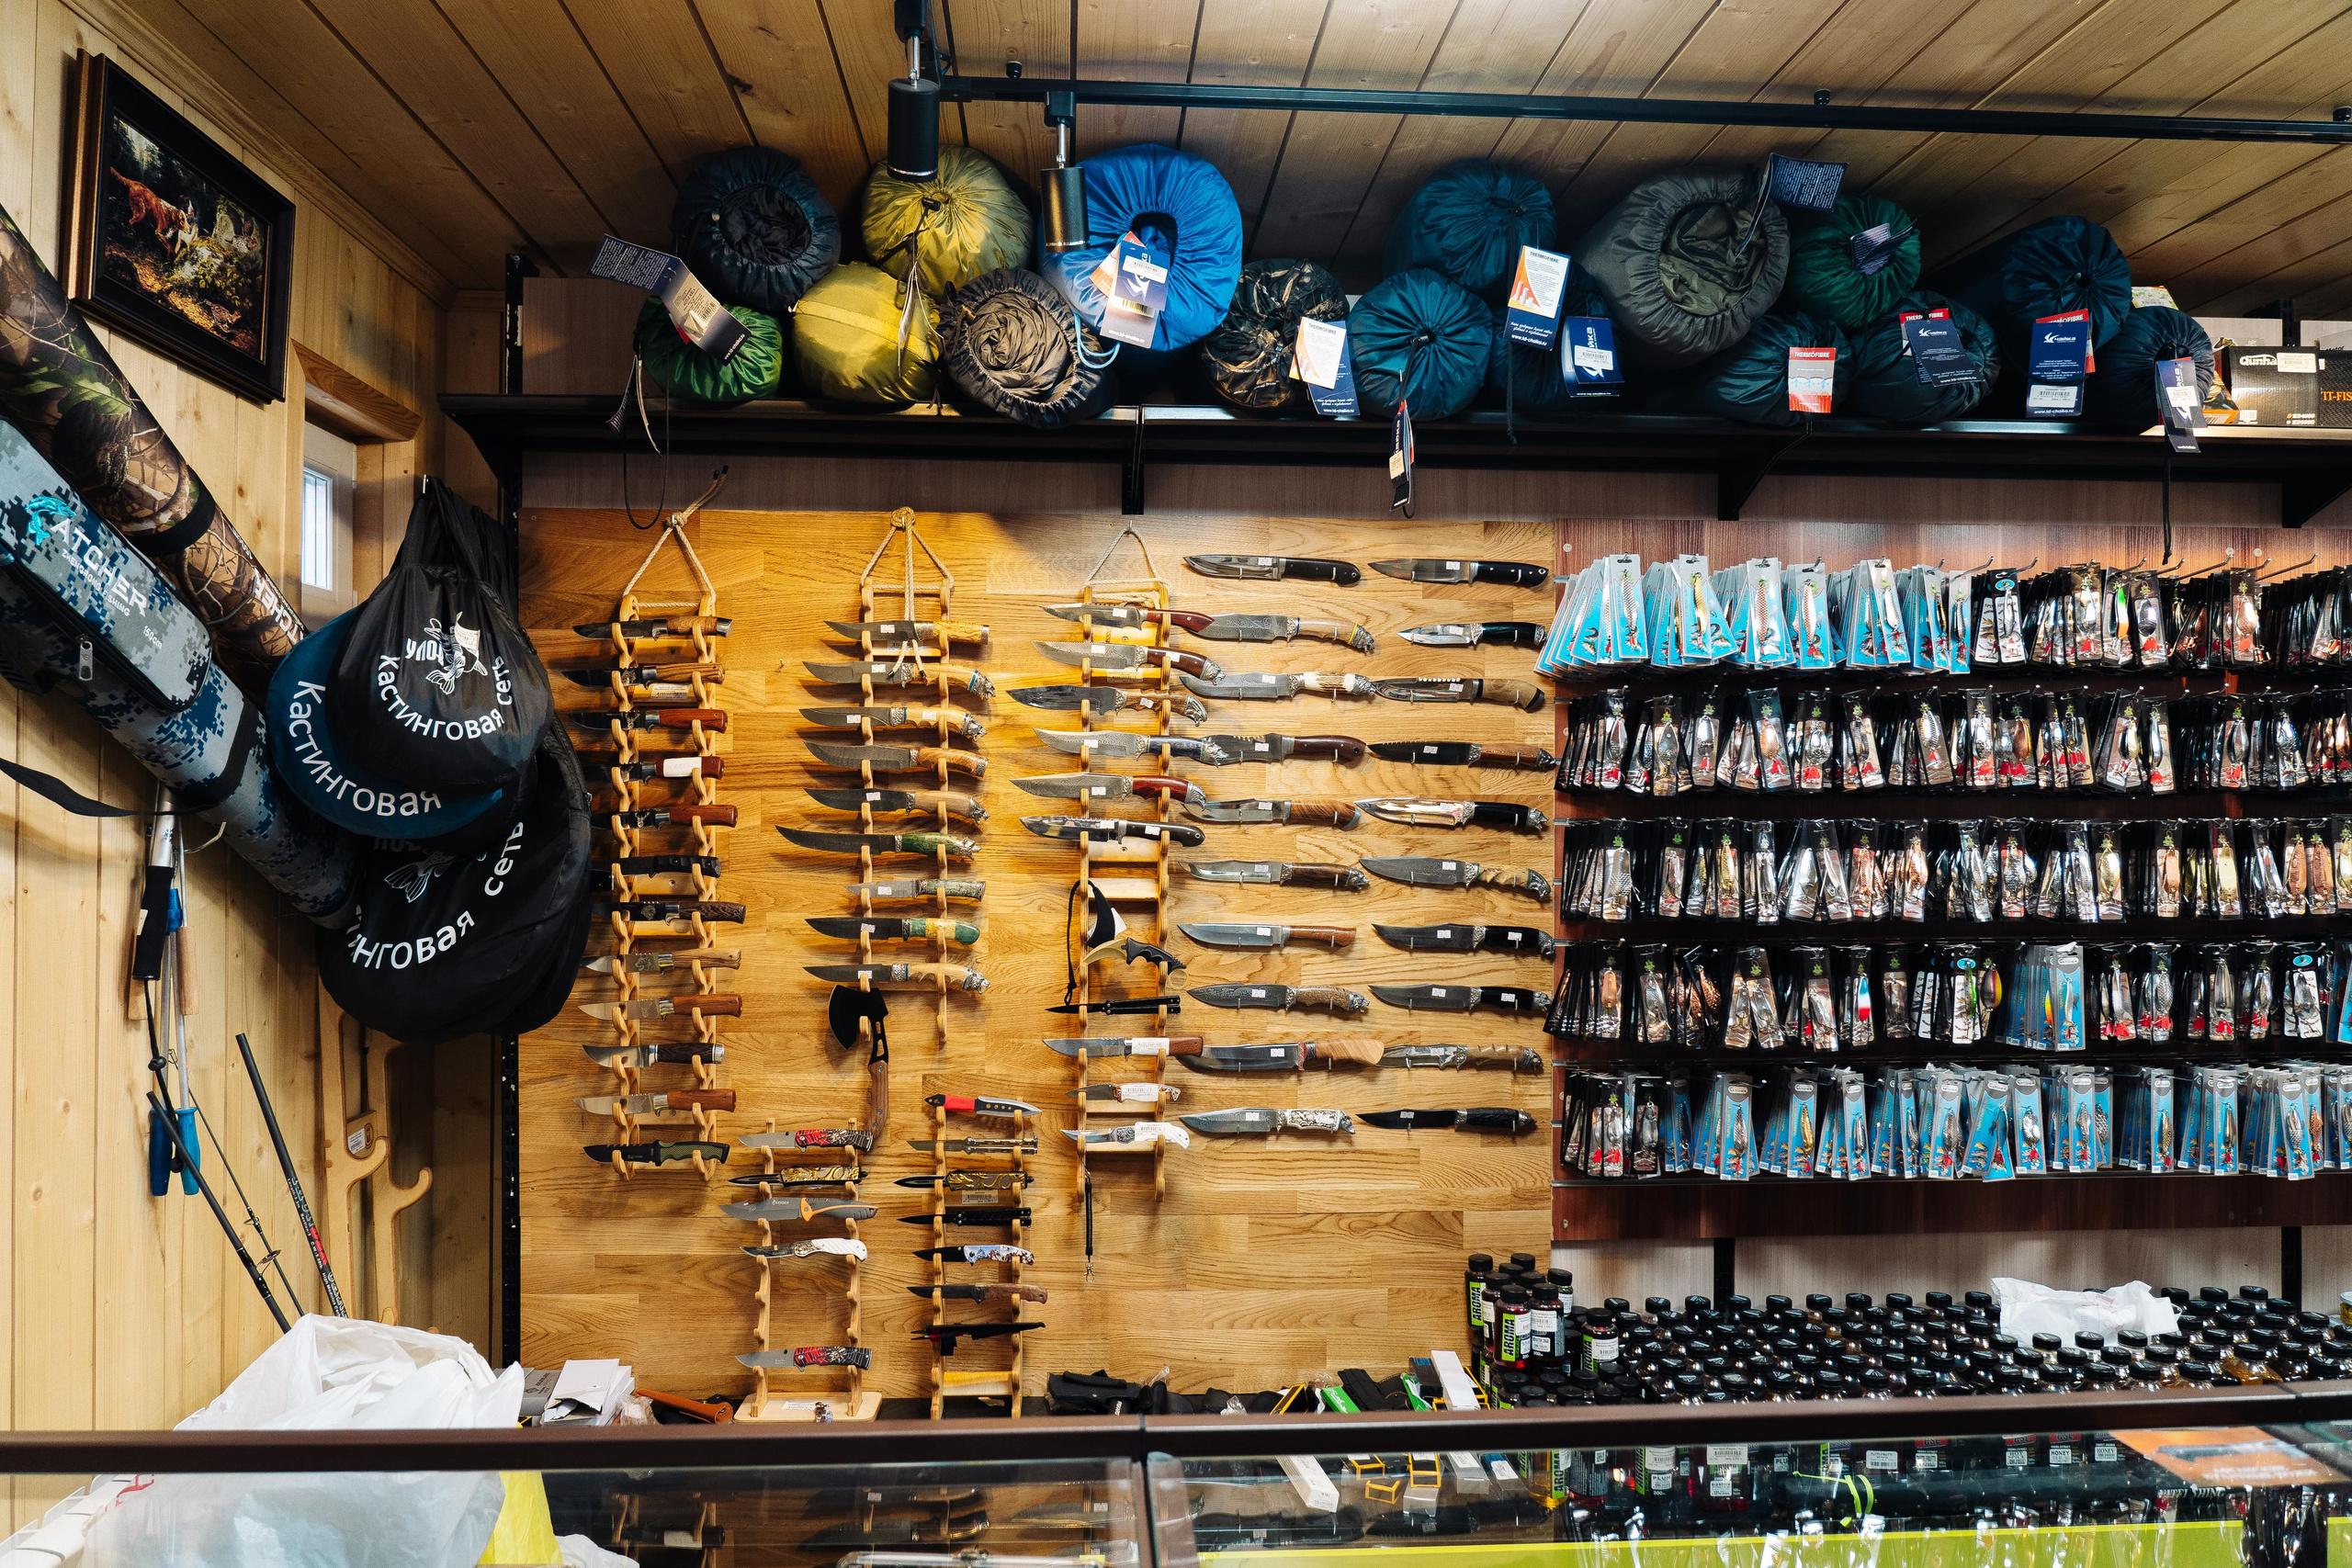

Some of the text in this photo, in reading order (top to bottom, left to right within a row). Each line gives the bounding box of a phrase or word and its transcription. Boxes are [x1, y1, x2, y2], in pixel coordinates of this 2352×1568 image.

[2239, 354, 2278, 366] Qunha
[62, 549, 130, 616] ZHENGRONG FISHING
[143, 625, 163, 650] 150cm
[378, 654, 513, 741] Кастинговая сеть
[289, 681, 442, 817] Кастинговая
[347, 822, 524, 970] нговая сеть
[1472, 1286, 1482, 1321] AROMA
[1504, 1319, 1515, 1357] AROMA
